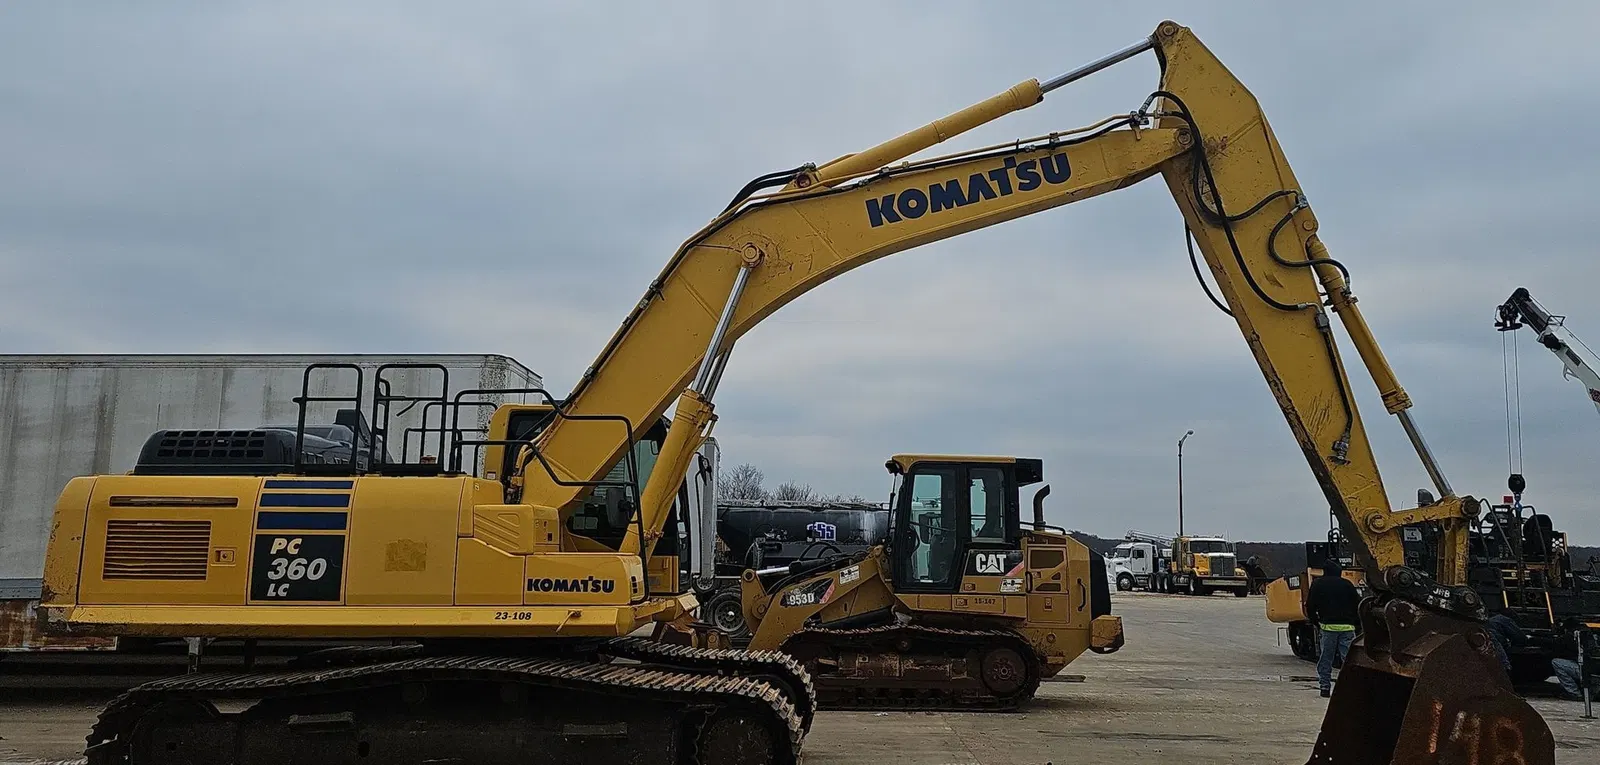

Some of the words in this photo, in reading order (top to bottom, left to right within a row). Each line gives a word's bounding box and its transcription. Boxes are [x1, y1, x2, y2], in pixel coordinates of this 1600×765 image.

[866, 153, 1072, 228] KOMATSU
[270, 537, 303, 555] PC
[267, 557, 327, 581] 360
[975, 553, 1007, 573] CAT
[266, 583, 290, 597] LC
[526, 575, 615, 593] KOMATSU
[789, 592, 815, 605] 953D
[494, 611, 532, 620] 23-108
